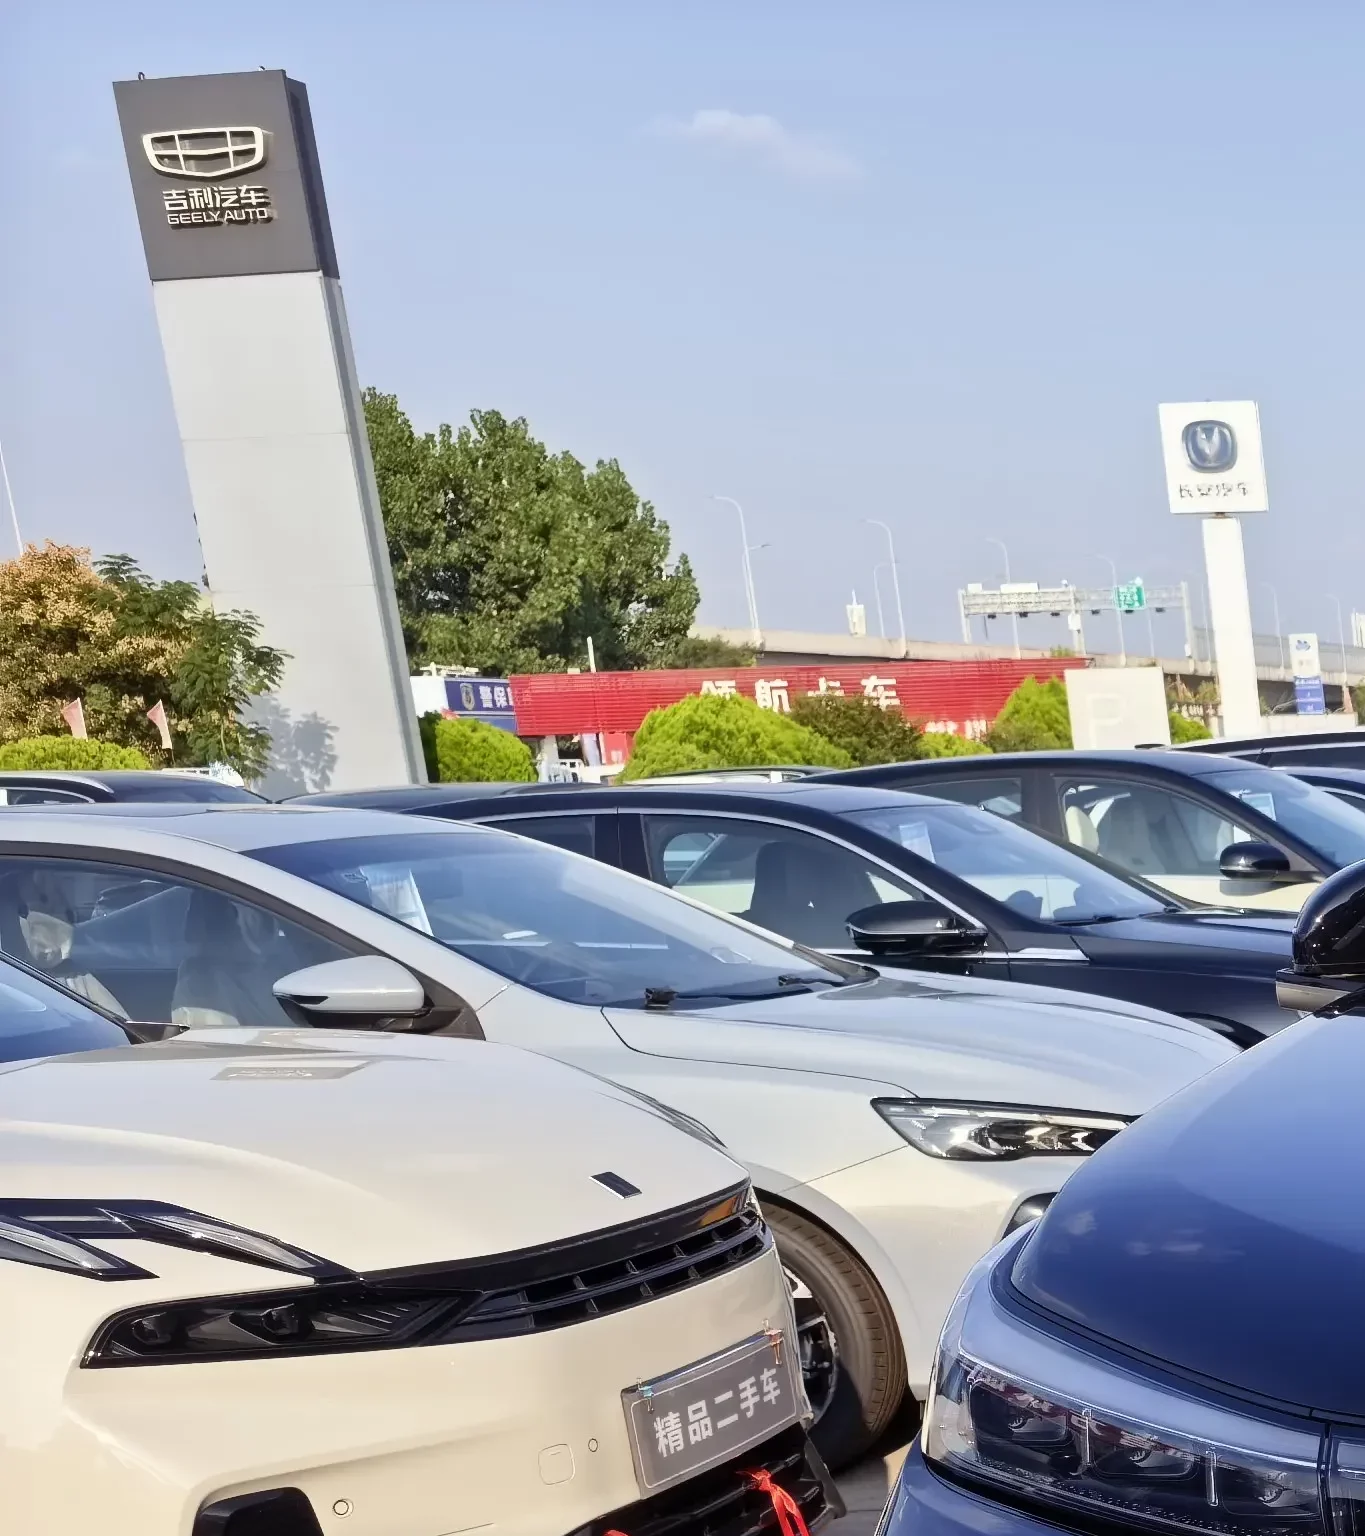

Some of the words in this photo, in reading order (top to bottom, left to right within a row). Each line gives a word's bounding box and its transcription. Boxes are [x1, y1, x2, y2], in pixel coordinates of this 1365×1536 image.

[162, 185, 266, 211] 吉利汽车
[167, 211, 221, 225] GEELY
[224, 207, 268, 221] AUTO
[653, 1367, 781, 1458] 精品二手车
